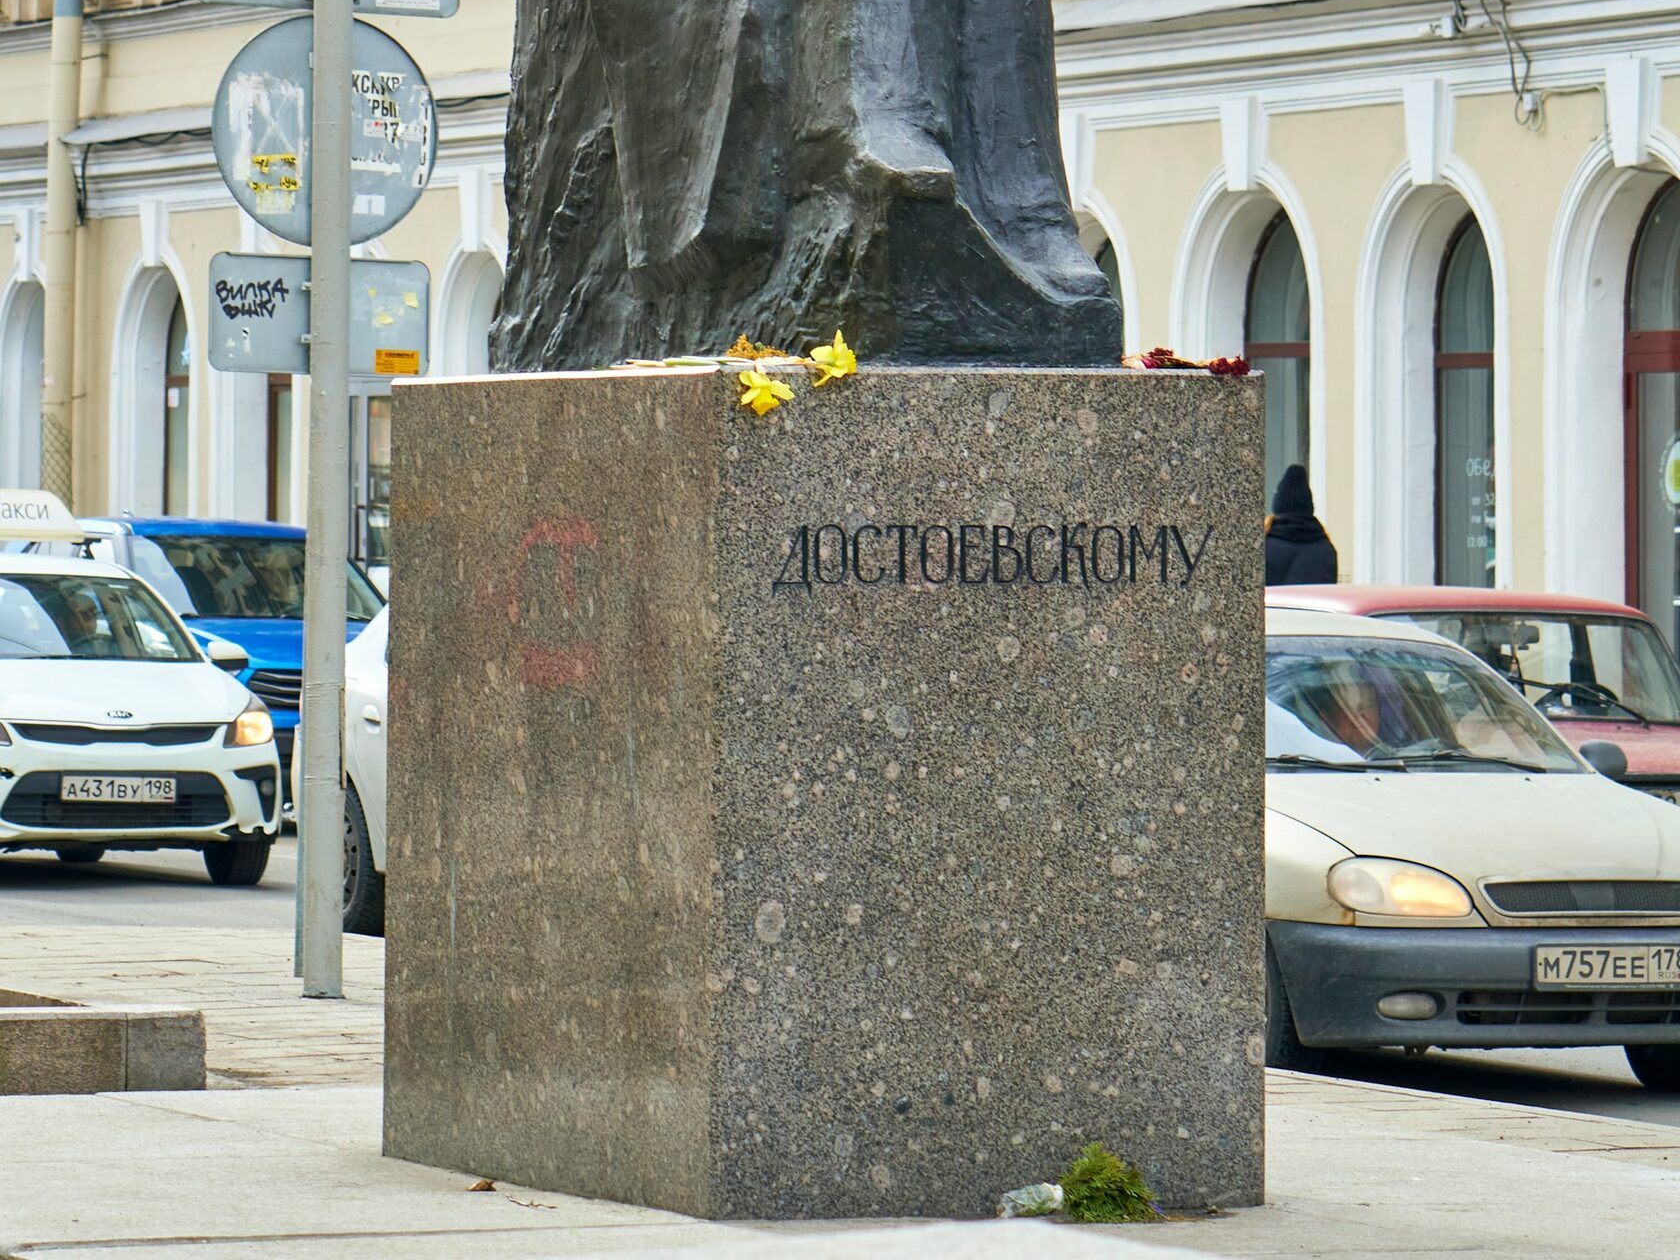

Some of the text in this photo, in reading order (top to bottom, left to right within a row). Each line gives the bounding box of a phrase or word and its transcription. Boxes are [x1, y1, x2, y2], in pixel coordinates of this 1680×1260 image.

[772, 523, 1213, 598] ДОСТОЕВСКОМУ
[145, 780, 172, 795] 198
[1543, 950, 1645, 979] М757ЕЕ
